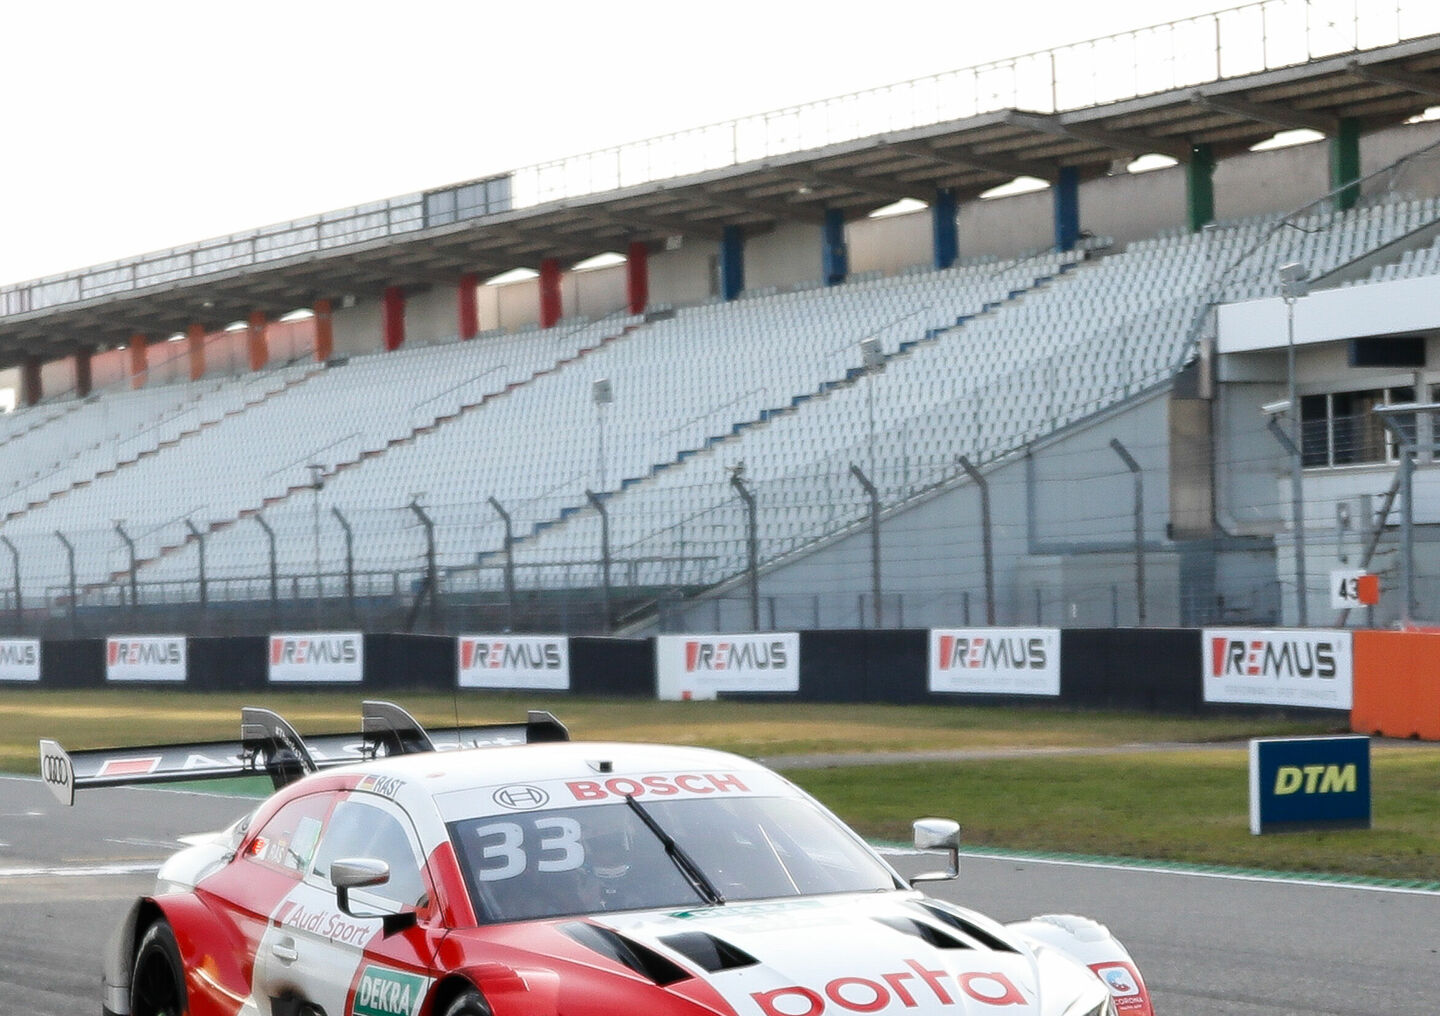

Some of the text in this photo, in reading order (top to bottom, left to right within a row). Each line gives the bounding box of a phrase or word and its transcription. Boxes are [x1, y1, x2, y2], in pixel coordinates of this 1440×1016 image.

[117, 641, 181, 666] REMUS
[281, 638, 356, 666] REMUS
[473, 642, 560, 670] REMUS
[697, 641, 787, 671] REMUS
[952, 638, 1047, 671] REMUS
[1226, 640, 1337, 680] REMUS
[373, 775, 407, 798] RAST
[565, 774, 752, 801] BOSCH
[1274, 764, 1357, 795] DTM
[476, 816, 585, 882] 33
[287, 904, 369, 945] Audi Sport
[361, 975, 410, 1016] DEKRA
